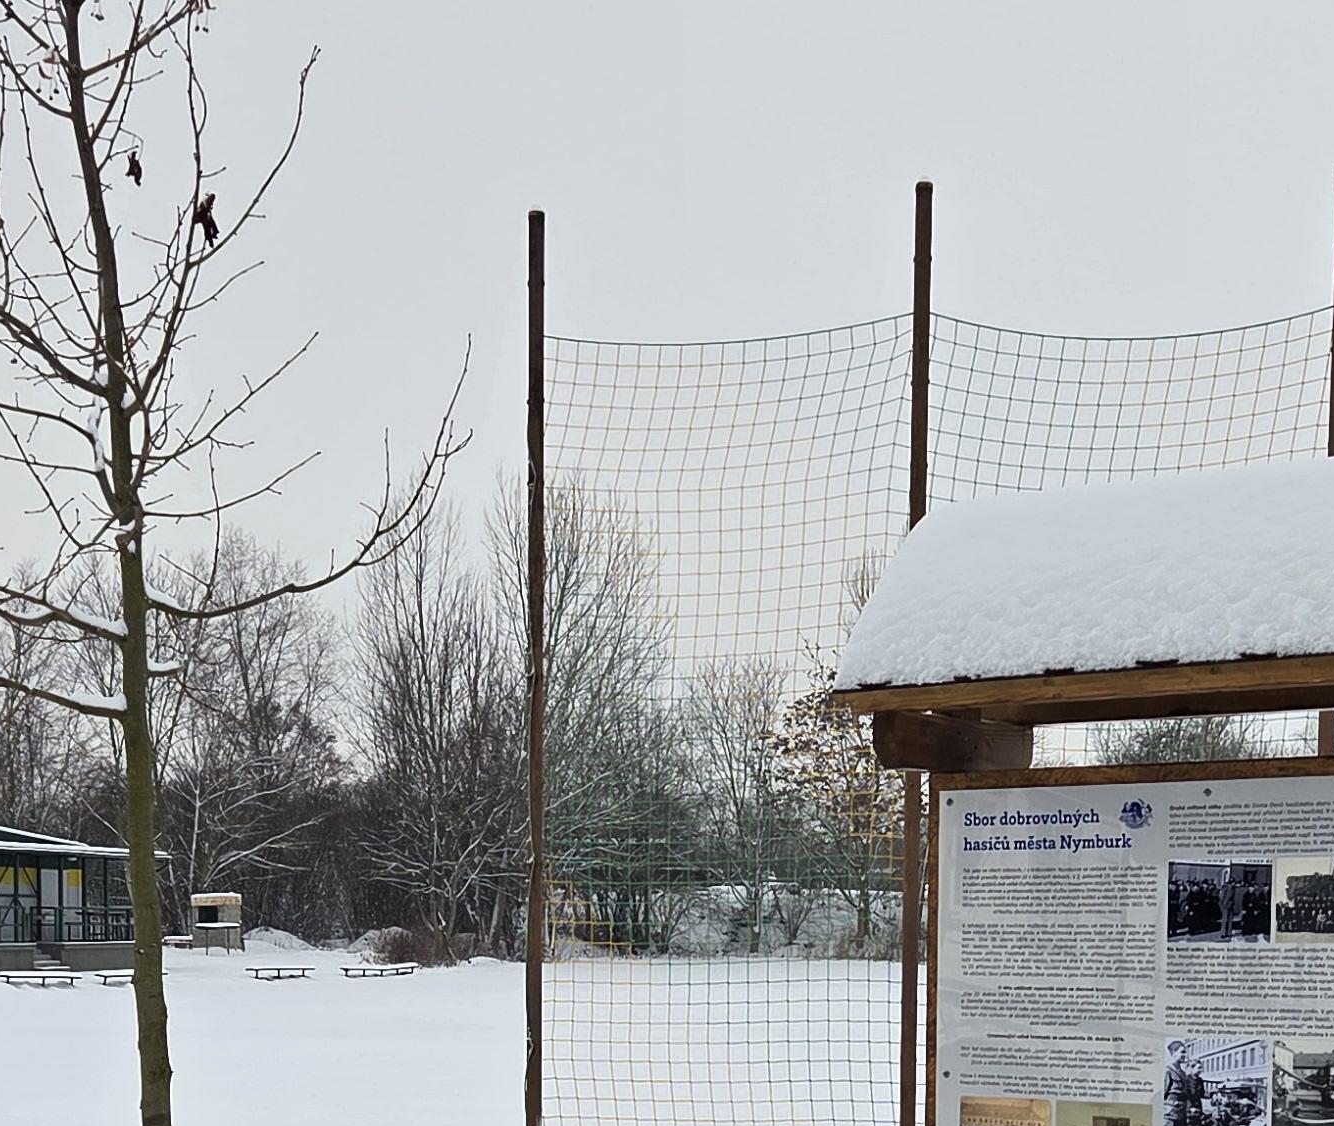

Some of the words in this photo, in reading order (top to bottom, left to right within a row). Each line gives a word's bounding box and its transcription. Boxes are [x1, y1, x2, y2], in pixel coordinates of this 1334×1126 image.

[964, 813, 997, 827] Sbor
[1000, 809, 1100, 828] dobrovolných
[963, 837, 1010, 851] hasičů
[1014, 835, 1056, 850] města
[1060, 833, 1132, 853] Nymburk
